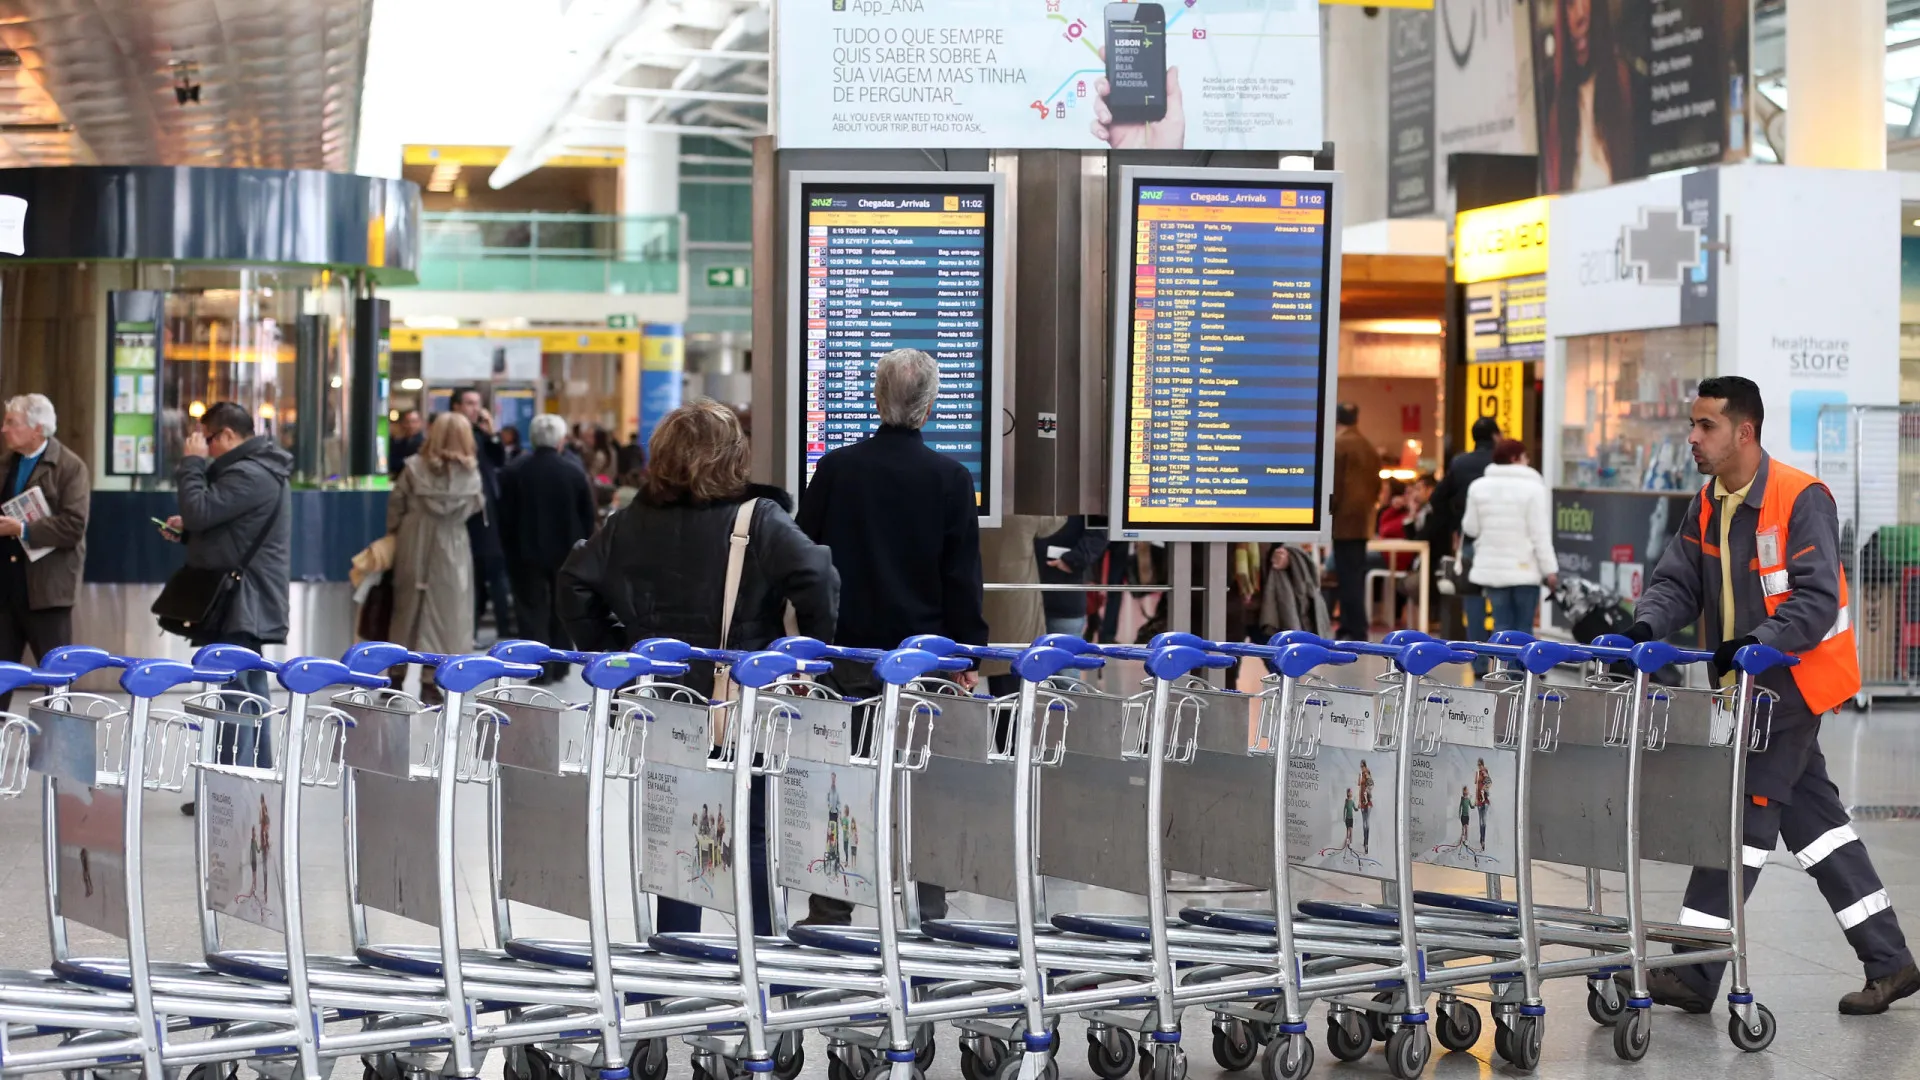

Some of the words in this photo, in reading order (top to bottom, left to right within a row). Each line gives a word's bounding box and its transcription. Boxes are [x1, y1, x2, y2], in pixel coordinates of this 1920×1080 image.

[852, 0, 925, 16] App_ANA
[833, 28, 880, 44] TUDO
[885, 28, 898, 44] O
[902, 28, 935, 47] QUE
[940, 29, 1004, 45] SEMPRE
[1114, 39, 1141, 47] LISBON
[833, 47, 871, 66] QUIS
[875, 48, 925, 64] SABER
[929, 48, 981, 64] SOBRE
[985, 49, 997, 64] A
[1115, 47, 1139, 55] PORTO
[1115, 55, 1134, 63] FARO
[1115, 63, 1133, 71] BEJA
[833, 67, 865, 83] SUA
[869, 67, 932, 83] VIAGEM
[937, 68, 974, 83] MAS
[978, 68, 1027, 84] TINHA
[1116, 71, 1143, 79] AZORES
[1116, 80, 1148, 88] MADEIRA
[833, 87, 855, 102] DE
[859, 87, 963, 106] PERGUNTAR_
[1202, 92, 1235, 100] Aeroporto
[832, 113, 847, 122] ALL
[849, 113, 868, 122] YOU
[870, 113, 892, 122] EVER
[893, 113, 931, 122] WANTED
[933, 113, 943, 122] TO
[945, 113, 973, 122] KNOW
[832, 123, 861, 132] ABOUT
[864, 123, 888, 132] YOUR
[890, 123, 909, 133] TRIP,
[911, 123, 927, 132] BUT
[930, 123, 950, 132] HAD
[952, 123, 962, 132] TO
[964, 123, 986, 133] ASK_
[858, 199, 895, 209] Chegadas
[1190, 193, 1229, 203] Chegadas
[1299, 196, 1322, 204] 11:02
[1772, 335, 1850, 350] healthcare
[1790, 351, 1850, 371] store
[1289, 760, 1318, 772] RALDÁRIO_
[1412, 758, 1433, 771] DÁRIO_
[648, 771, 658, 780] SALA
[658, 773, 664, 782] DE
[665, 774, 677, 784] ESTAR
[784, 776, 791, 784] DE
[648, 781, 654, 790] EM
[1291, 780, 1319, 791] CONFORTO
[1411, 779, 1433, 789] NFORTO
[652, 793, 664, 803] LUGAR
[665, 796, 678, 806] CERTO
[785, 797, 795, 805] PARA
[784, 808, 808, 820] CONFORTO
[785, 818, 796, 827] PARA
[796, 820, 811, 831] TODOS
